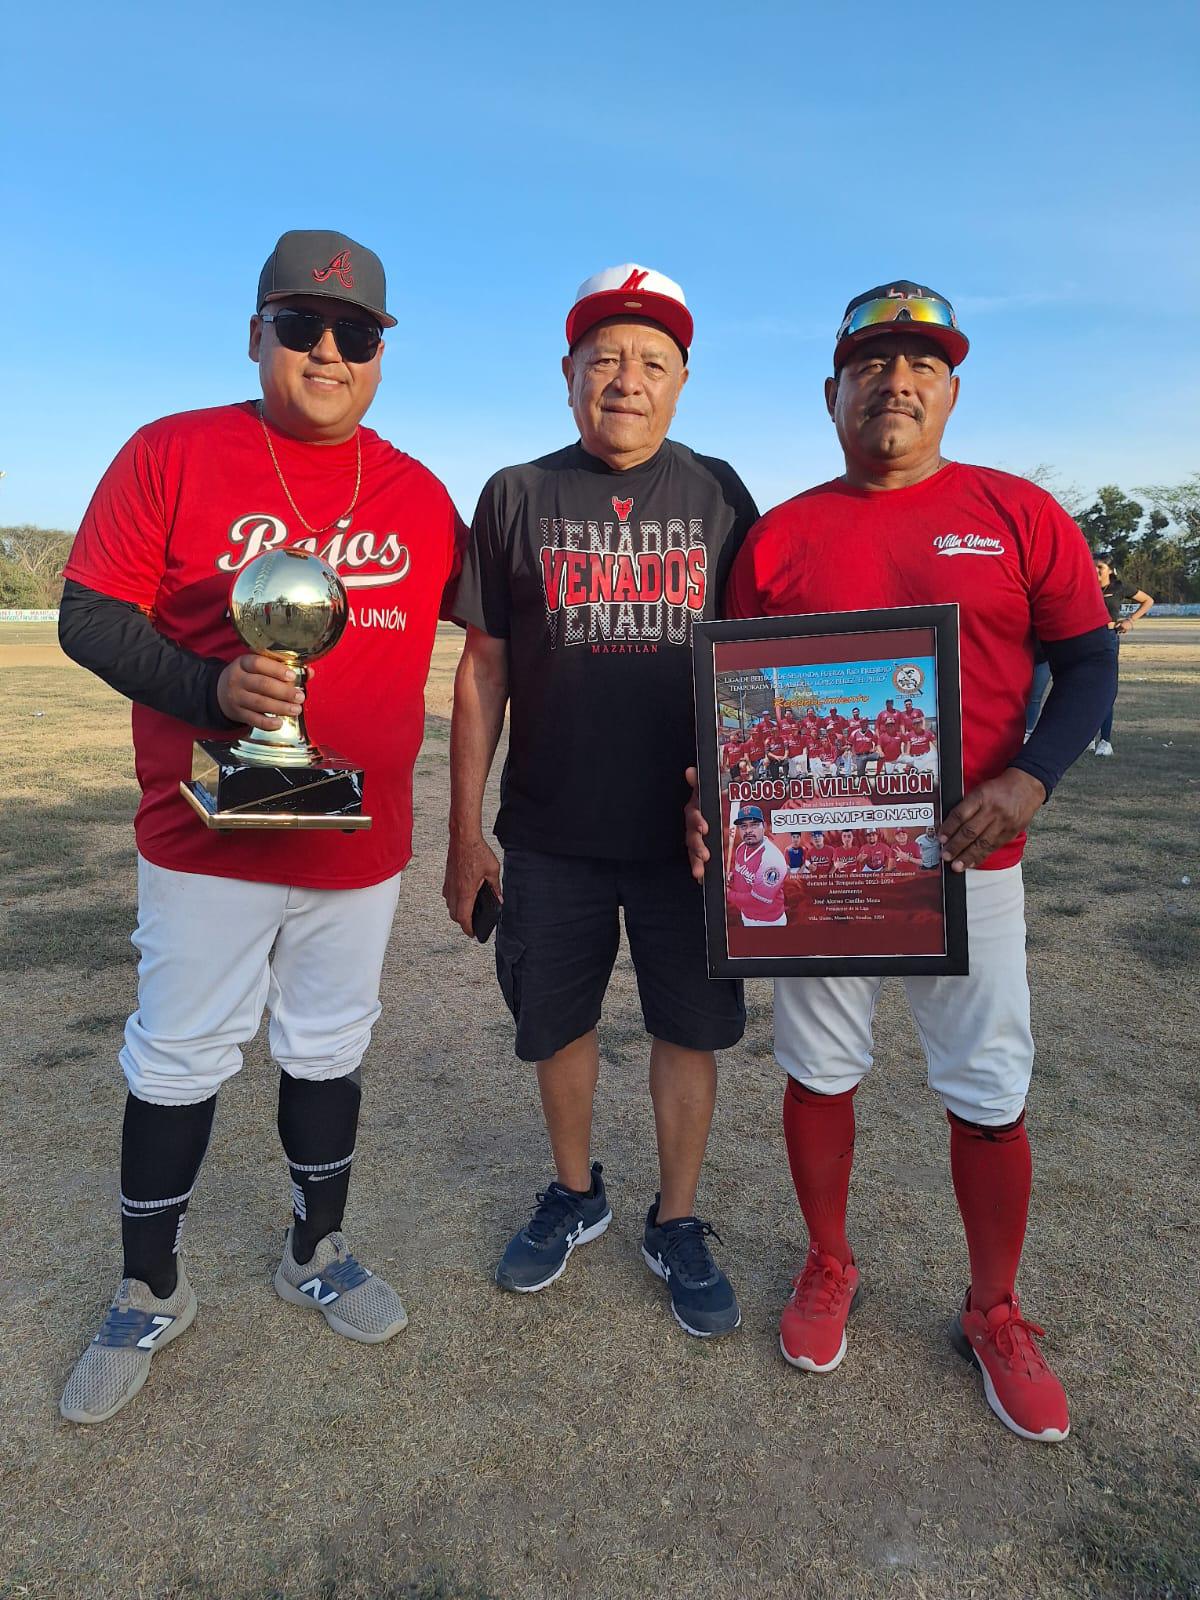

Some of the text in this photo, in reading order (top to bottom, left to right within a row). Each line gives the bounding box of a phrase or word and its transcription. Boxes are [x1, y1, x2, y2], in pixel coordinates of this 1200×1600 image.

[312, 249, 353, 288] A
[933, 533, 962, 548] Villa
[540, 546, 707, 613] VENADOS
[360, 605, 406, 632] UNIÓN
[728, 768, 933, 801] ROJOS DE VILLA UNIÓN
[773, 807, 934, 826] SUBCAMPEONATO
